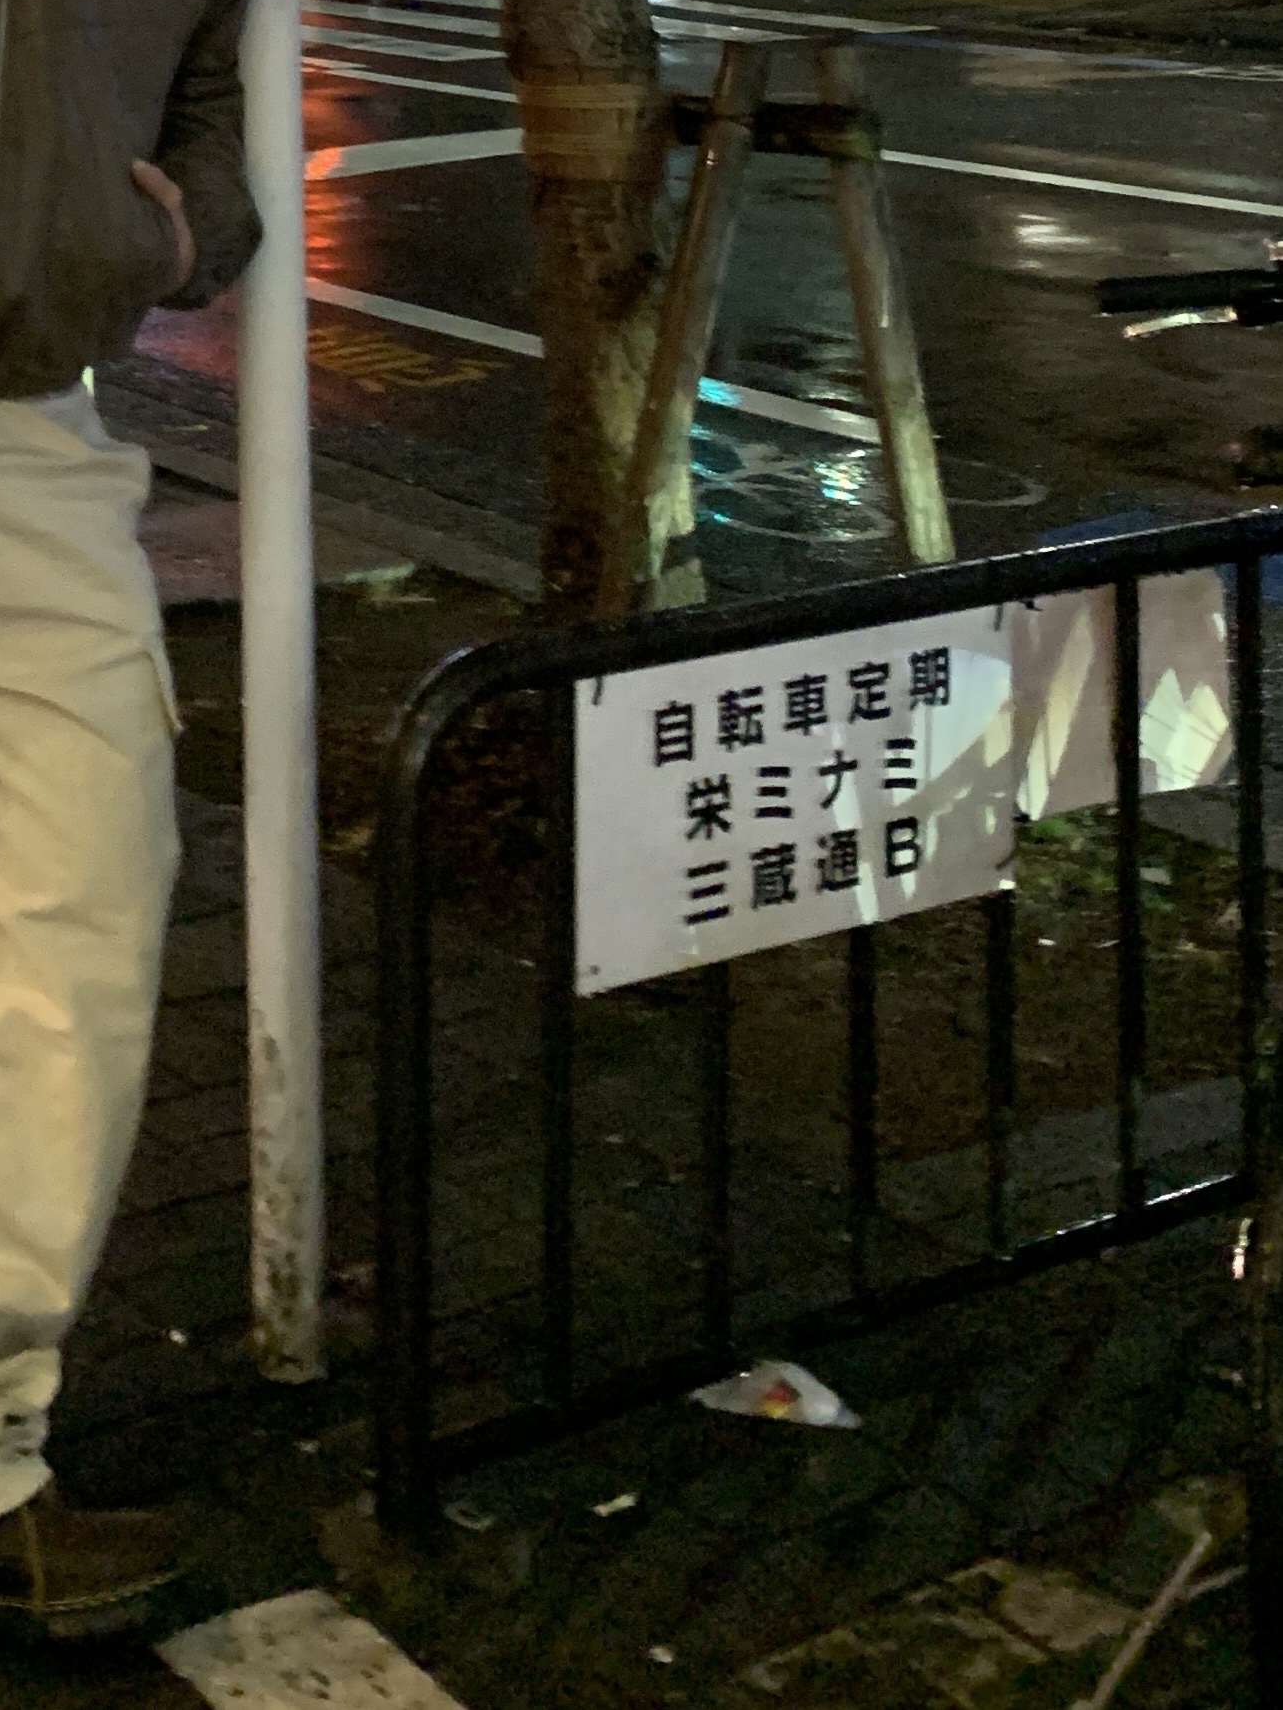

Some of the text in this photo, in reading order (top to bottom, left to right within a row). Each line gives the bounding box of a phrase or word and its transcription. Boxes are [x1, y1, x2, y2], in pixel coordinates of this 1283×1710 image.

[652, 647, 951, 768] 自転車定期
